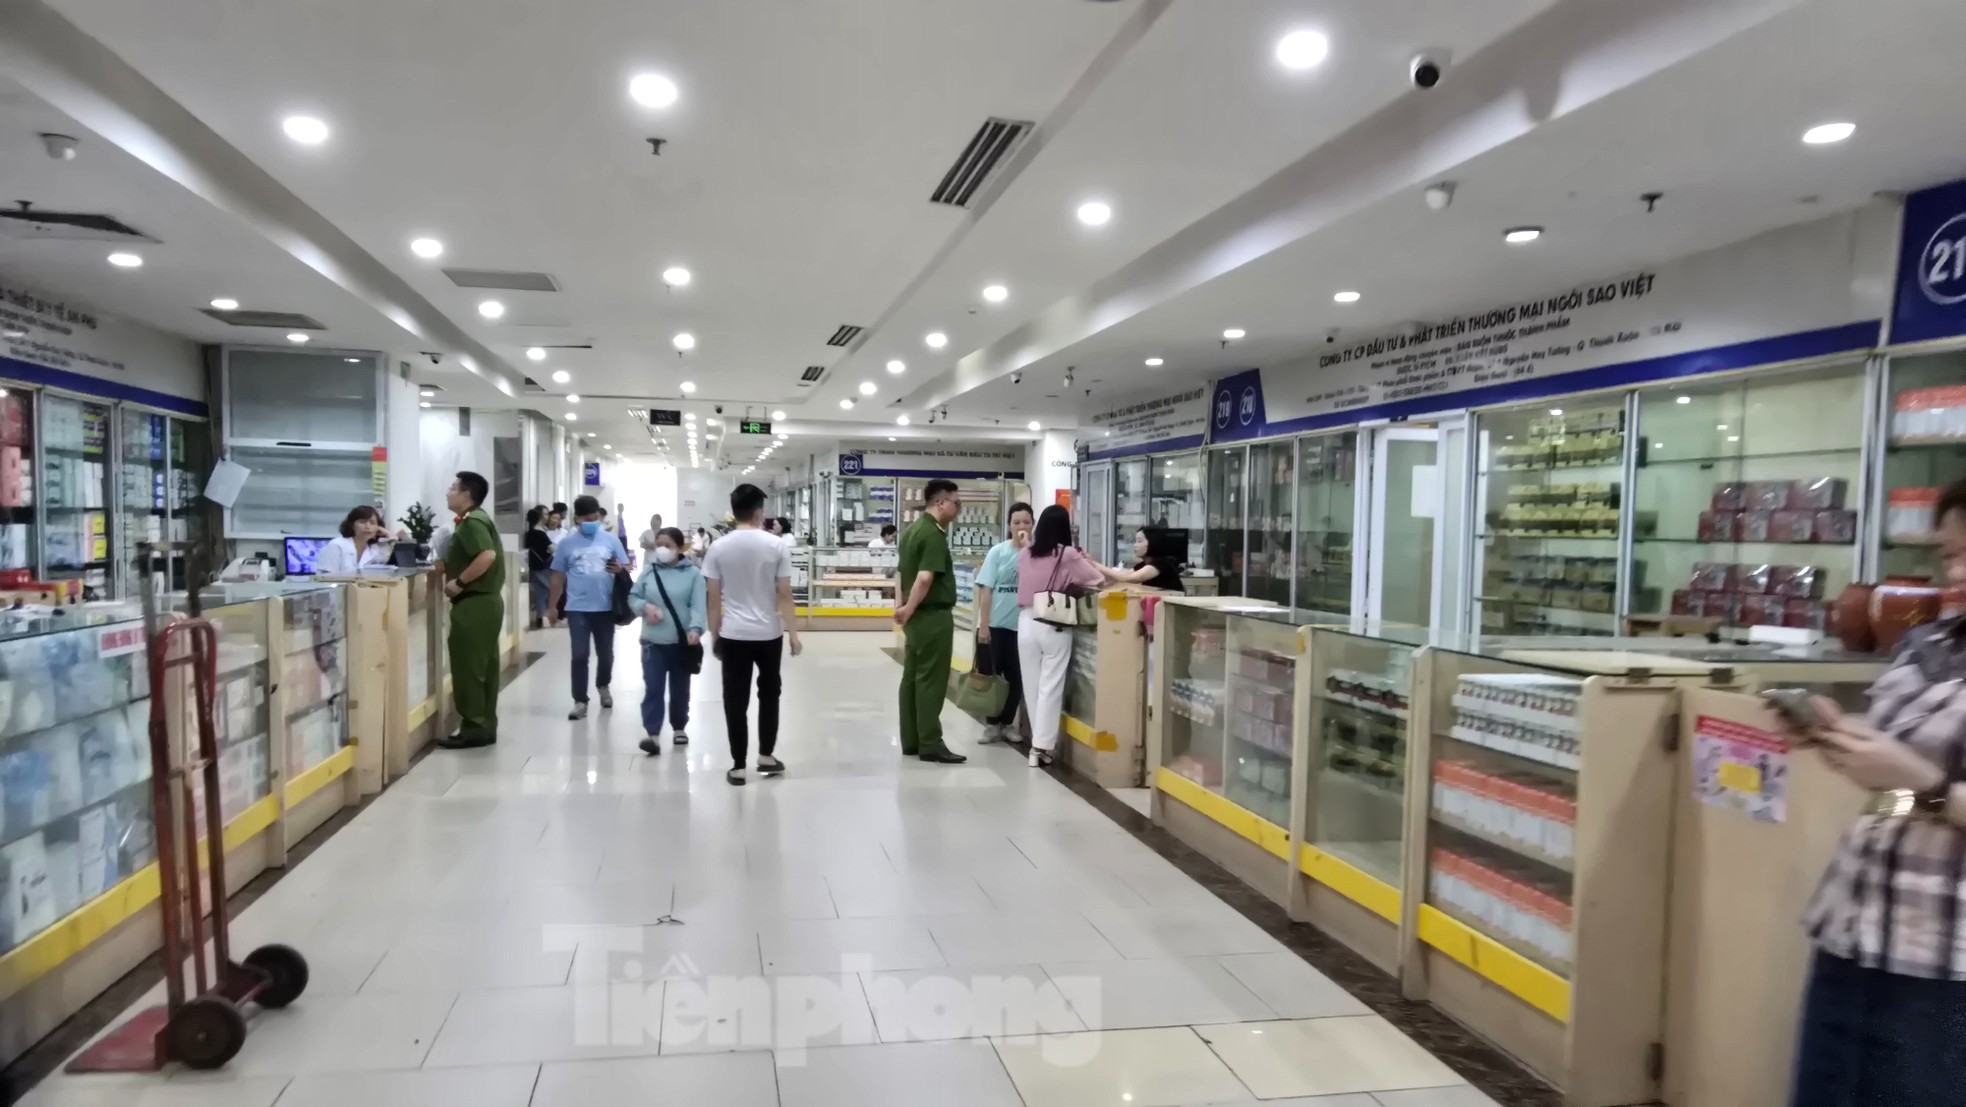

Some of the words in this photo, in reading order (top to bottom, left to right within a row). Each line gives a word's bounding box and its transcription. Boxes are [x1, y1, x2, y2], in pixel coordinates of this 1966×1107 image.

[1343, 348, 1353, 362] TY
[1354, 346, 1365, 360] CP
[1409, 326, 1433, 347] PHÁT
[1468, 306, 1516, 332] THƯƠNG
[1519, 301, 1543, 323] MẠI
[1547, 288, 1582, 315] NGÔI
[1586, 284, 1617, 306] SAO
[1621, 272, 1656, 300] VIỆT
[843, 460, 858, 470] 221
